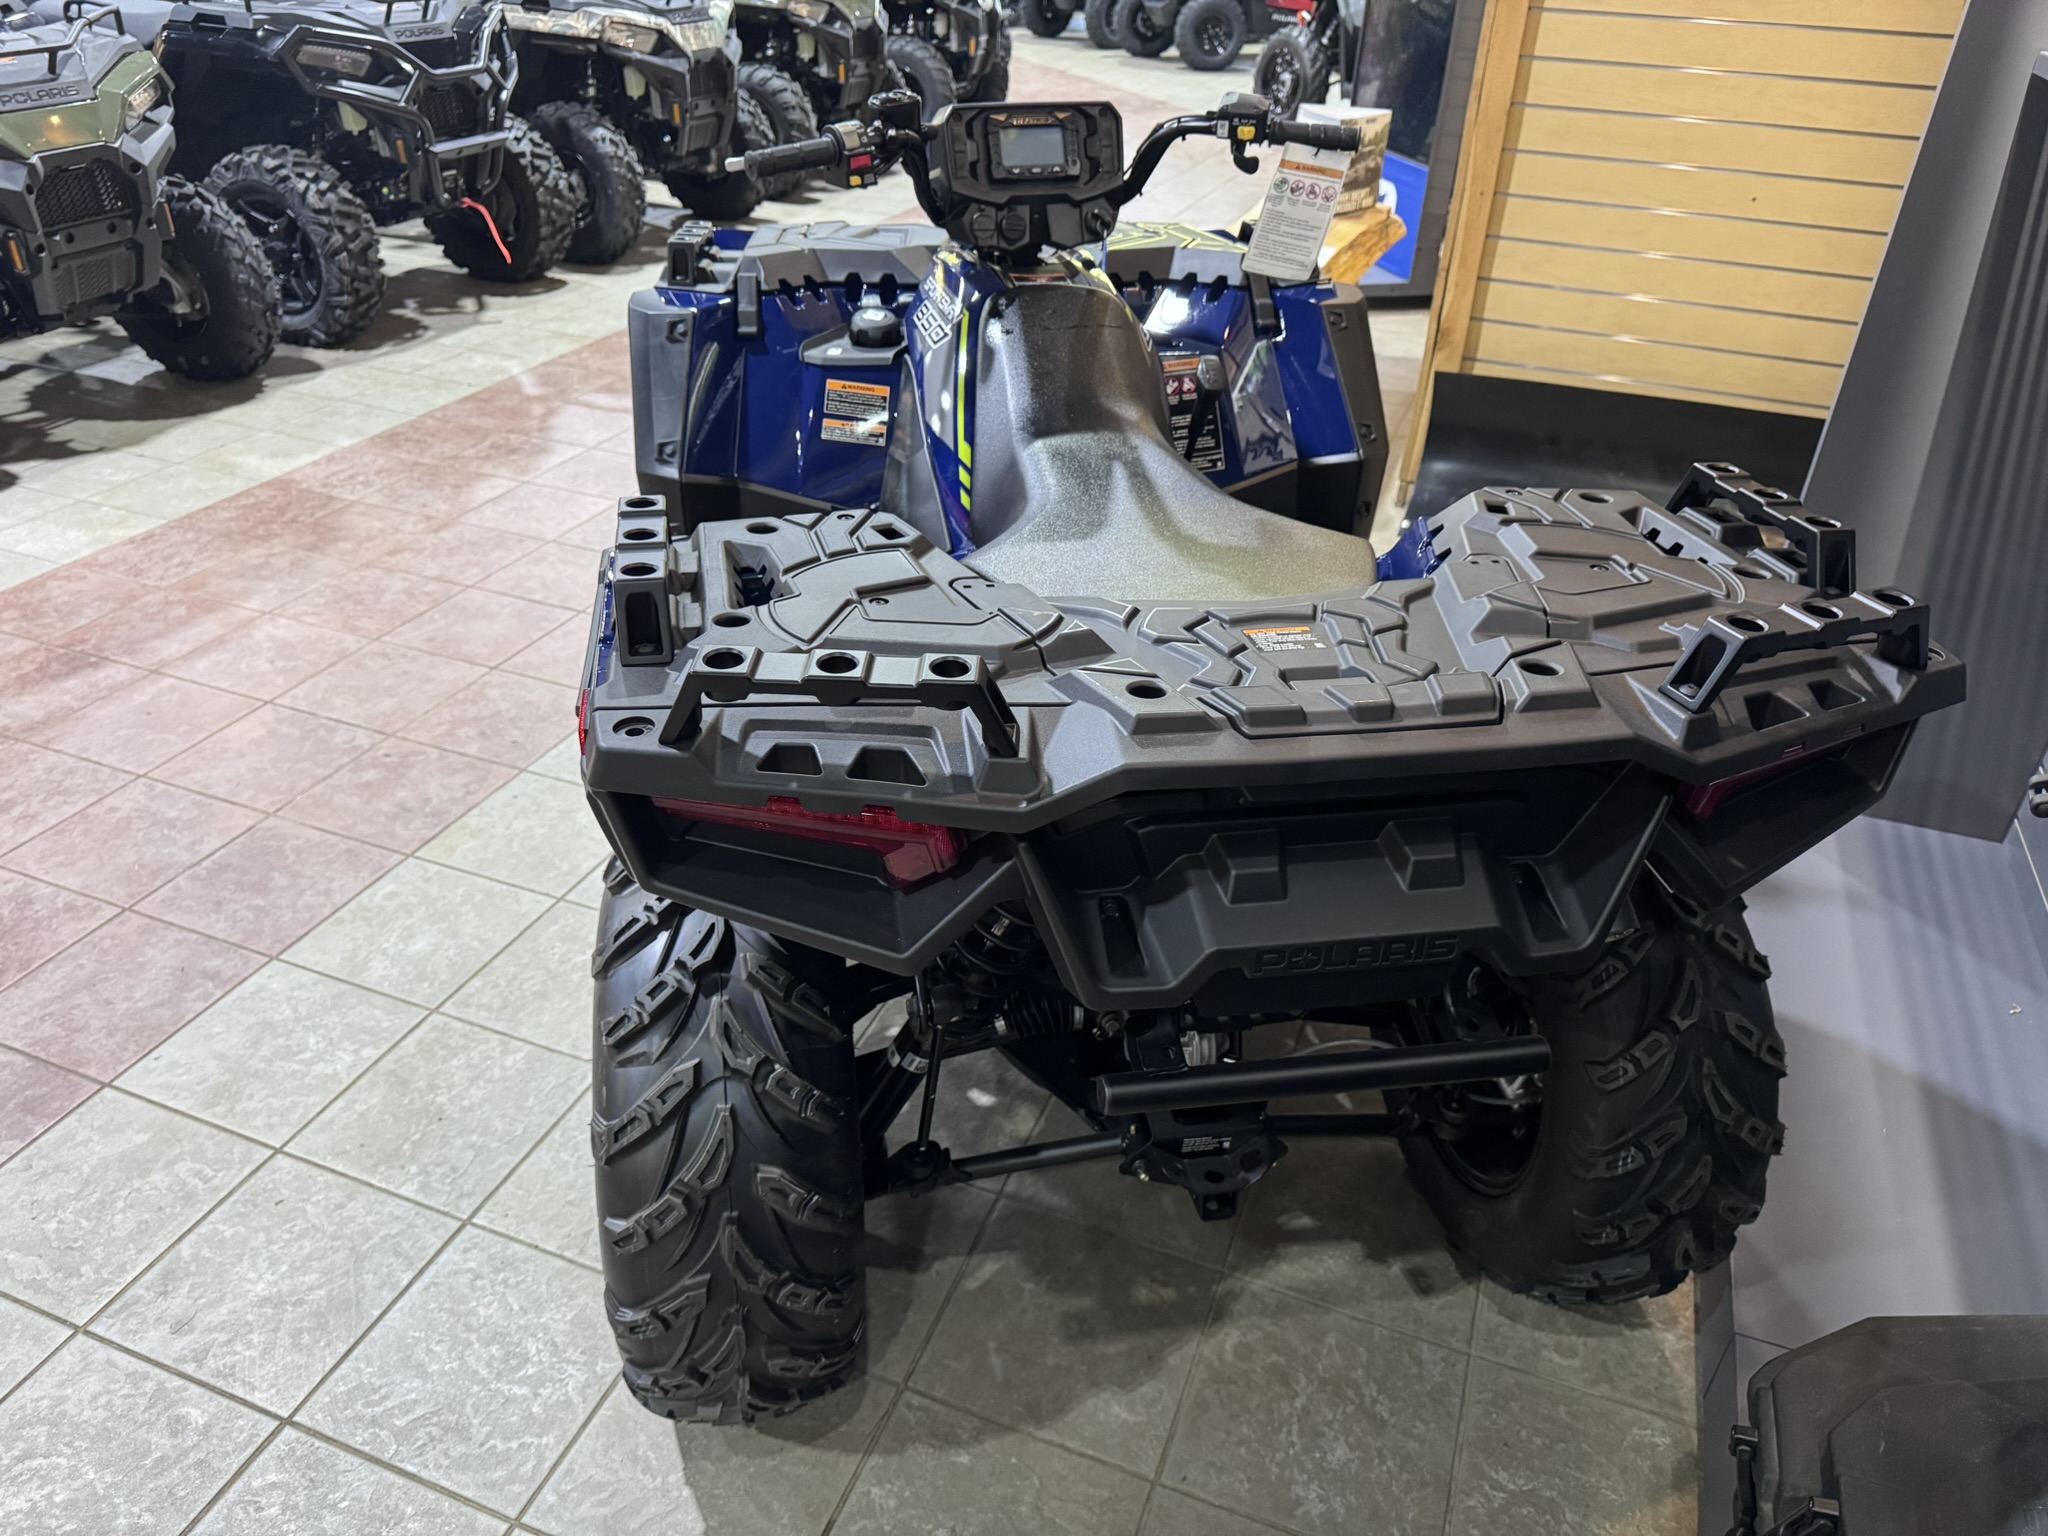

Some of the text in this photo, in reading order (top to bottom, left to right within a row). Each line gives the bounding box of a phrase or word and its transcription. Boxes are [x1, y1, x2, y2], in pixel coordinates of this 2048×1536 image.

[0, 85, 79, 107] POLARIS
[913, 299, 952, 349] 850
[847, 384, 876, 393] WARNING
[1253, 936, 1458, 976] POLARIS
